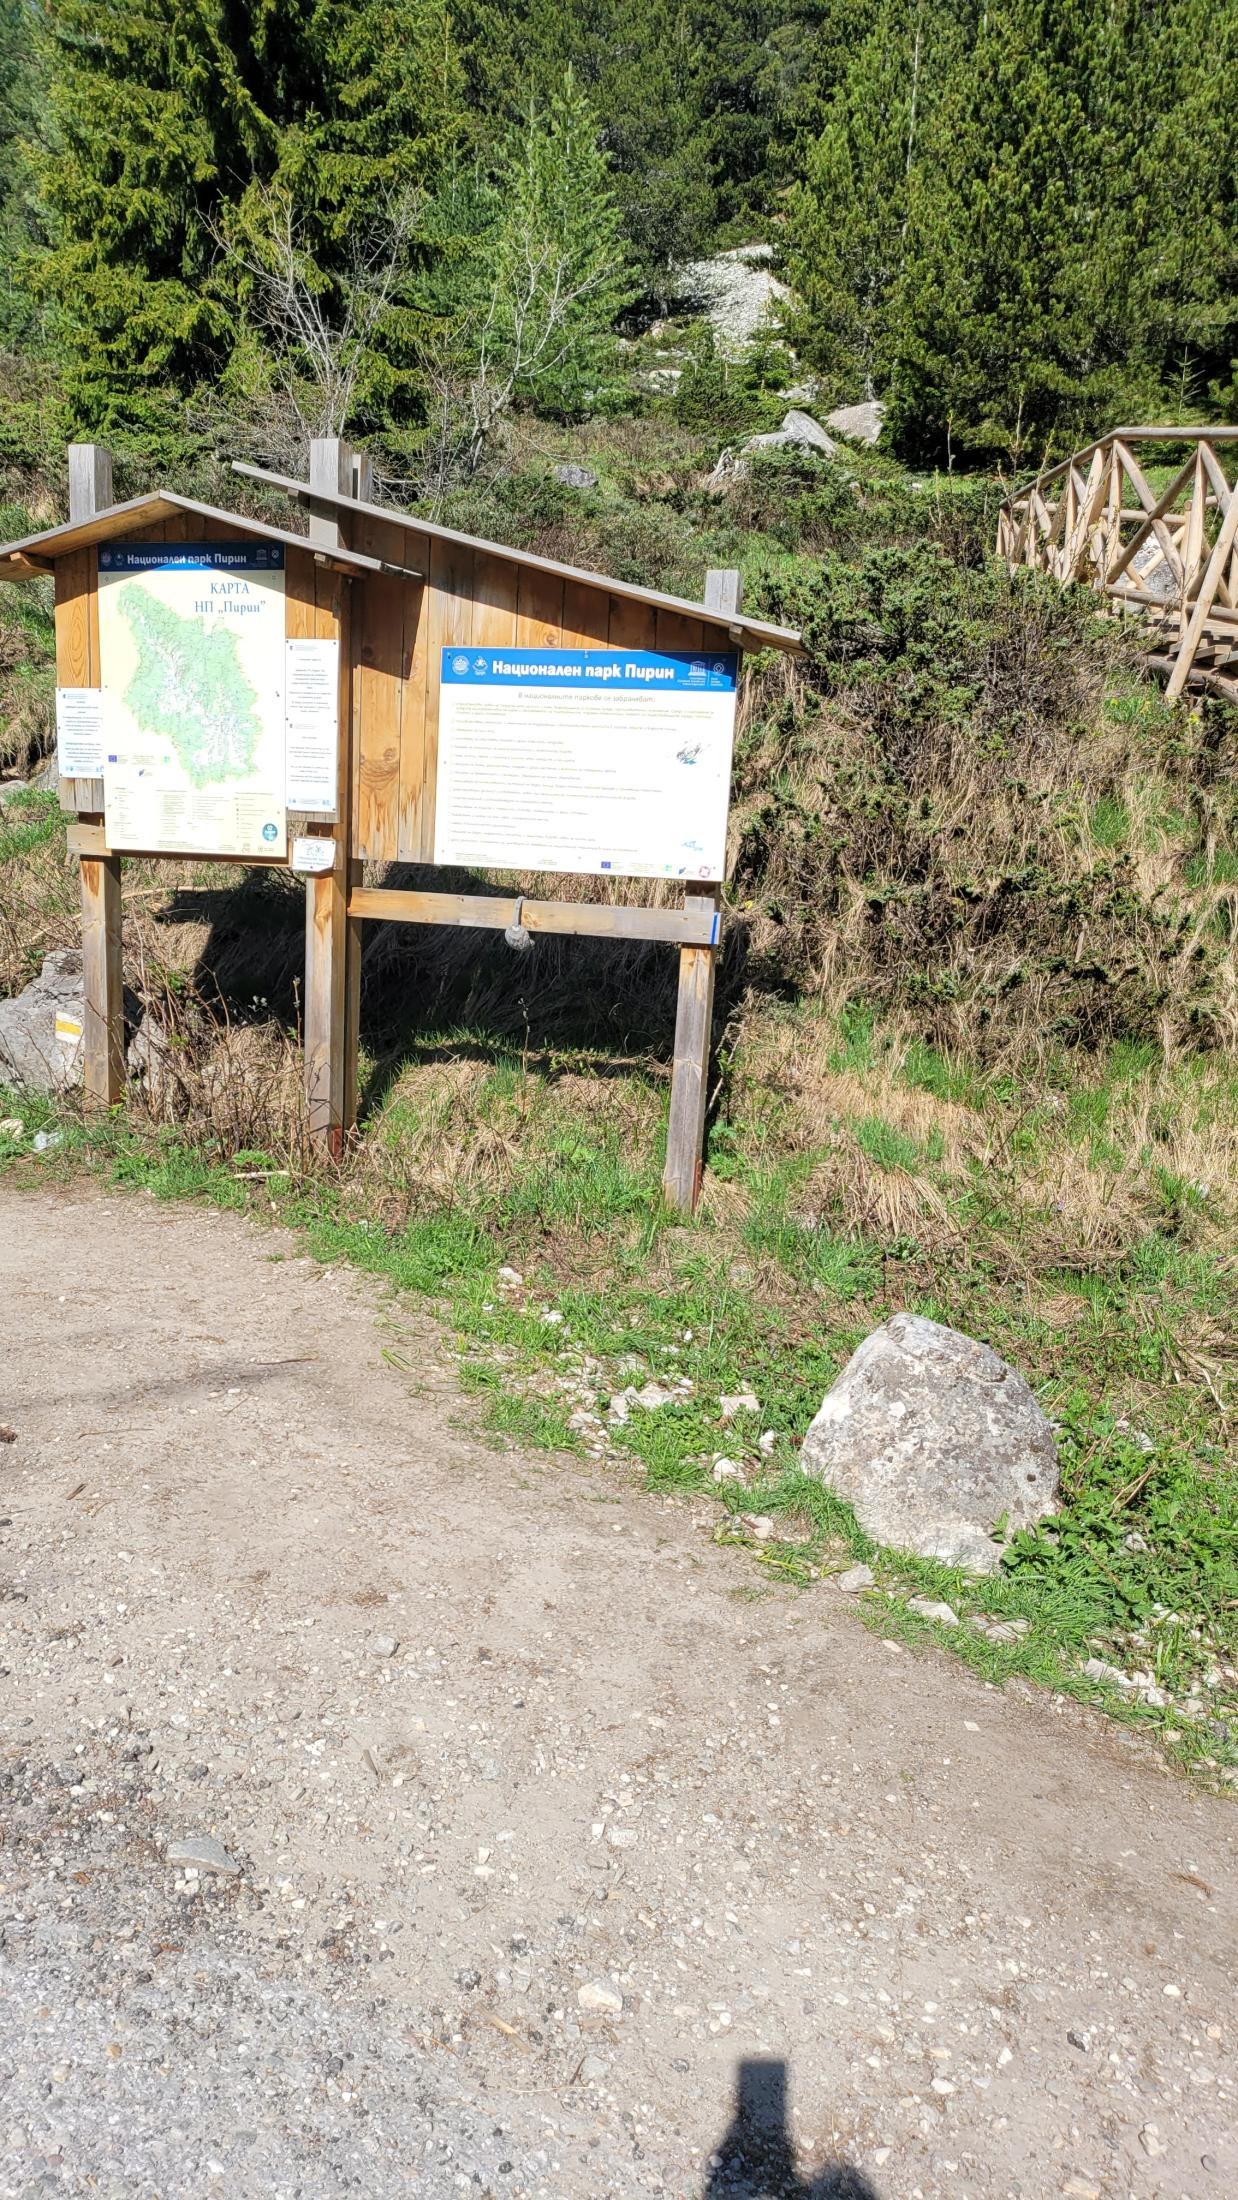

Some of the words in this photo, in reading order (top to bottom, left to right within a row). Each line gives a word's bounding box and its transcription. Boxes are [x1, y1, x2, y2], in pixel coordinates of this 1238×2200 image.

[127, 554, 186, 566] Национален
[188, 554, 211, 566] парк
[214, 553, 247, 566] Пирин
[210, 582, 250, 594] КАРТА
[195, 601, 213, 613] НП
[492, 660, 582, 677] Национален
[585, 664, 622, 680] парк
[625, 664, 675, 681] Пирин
